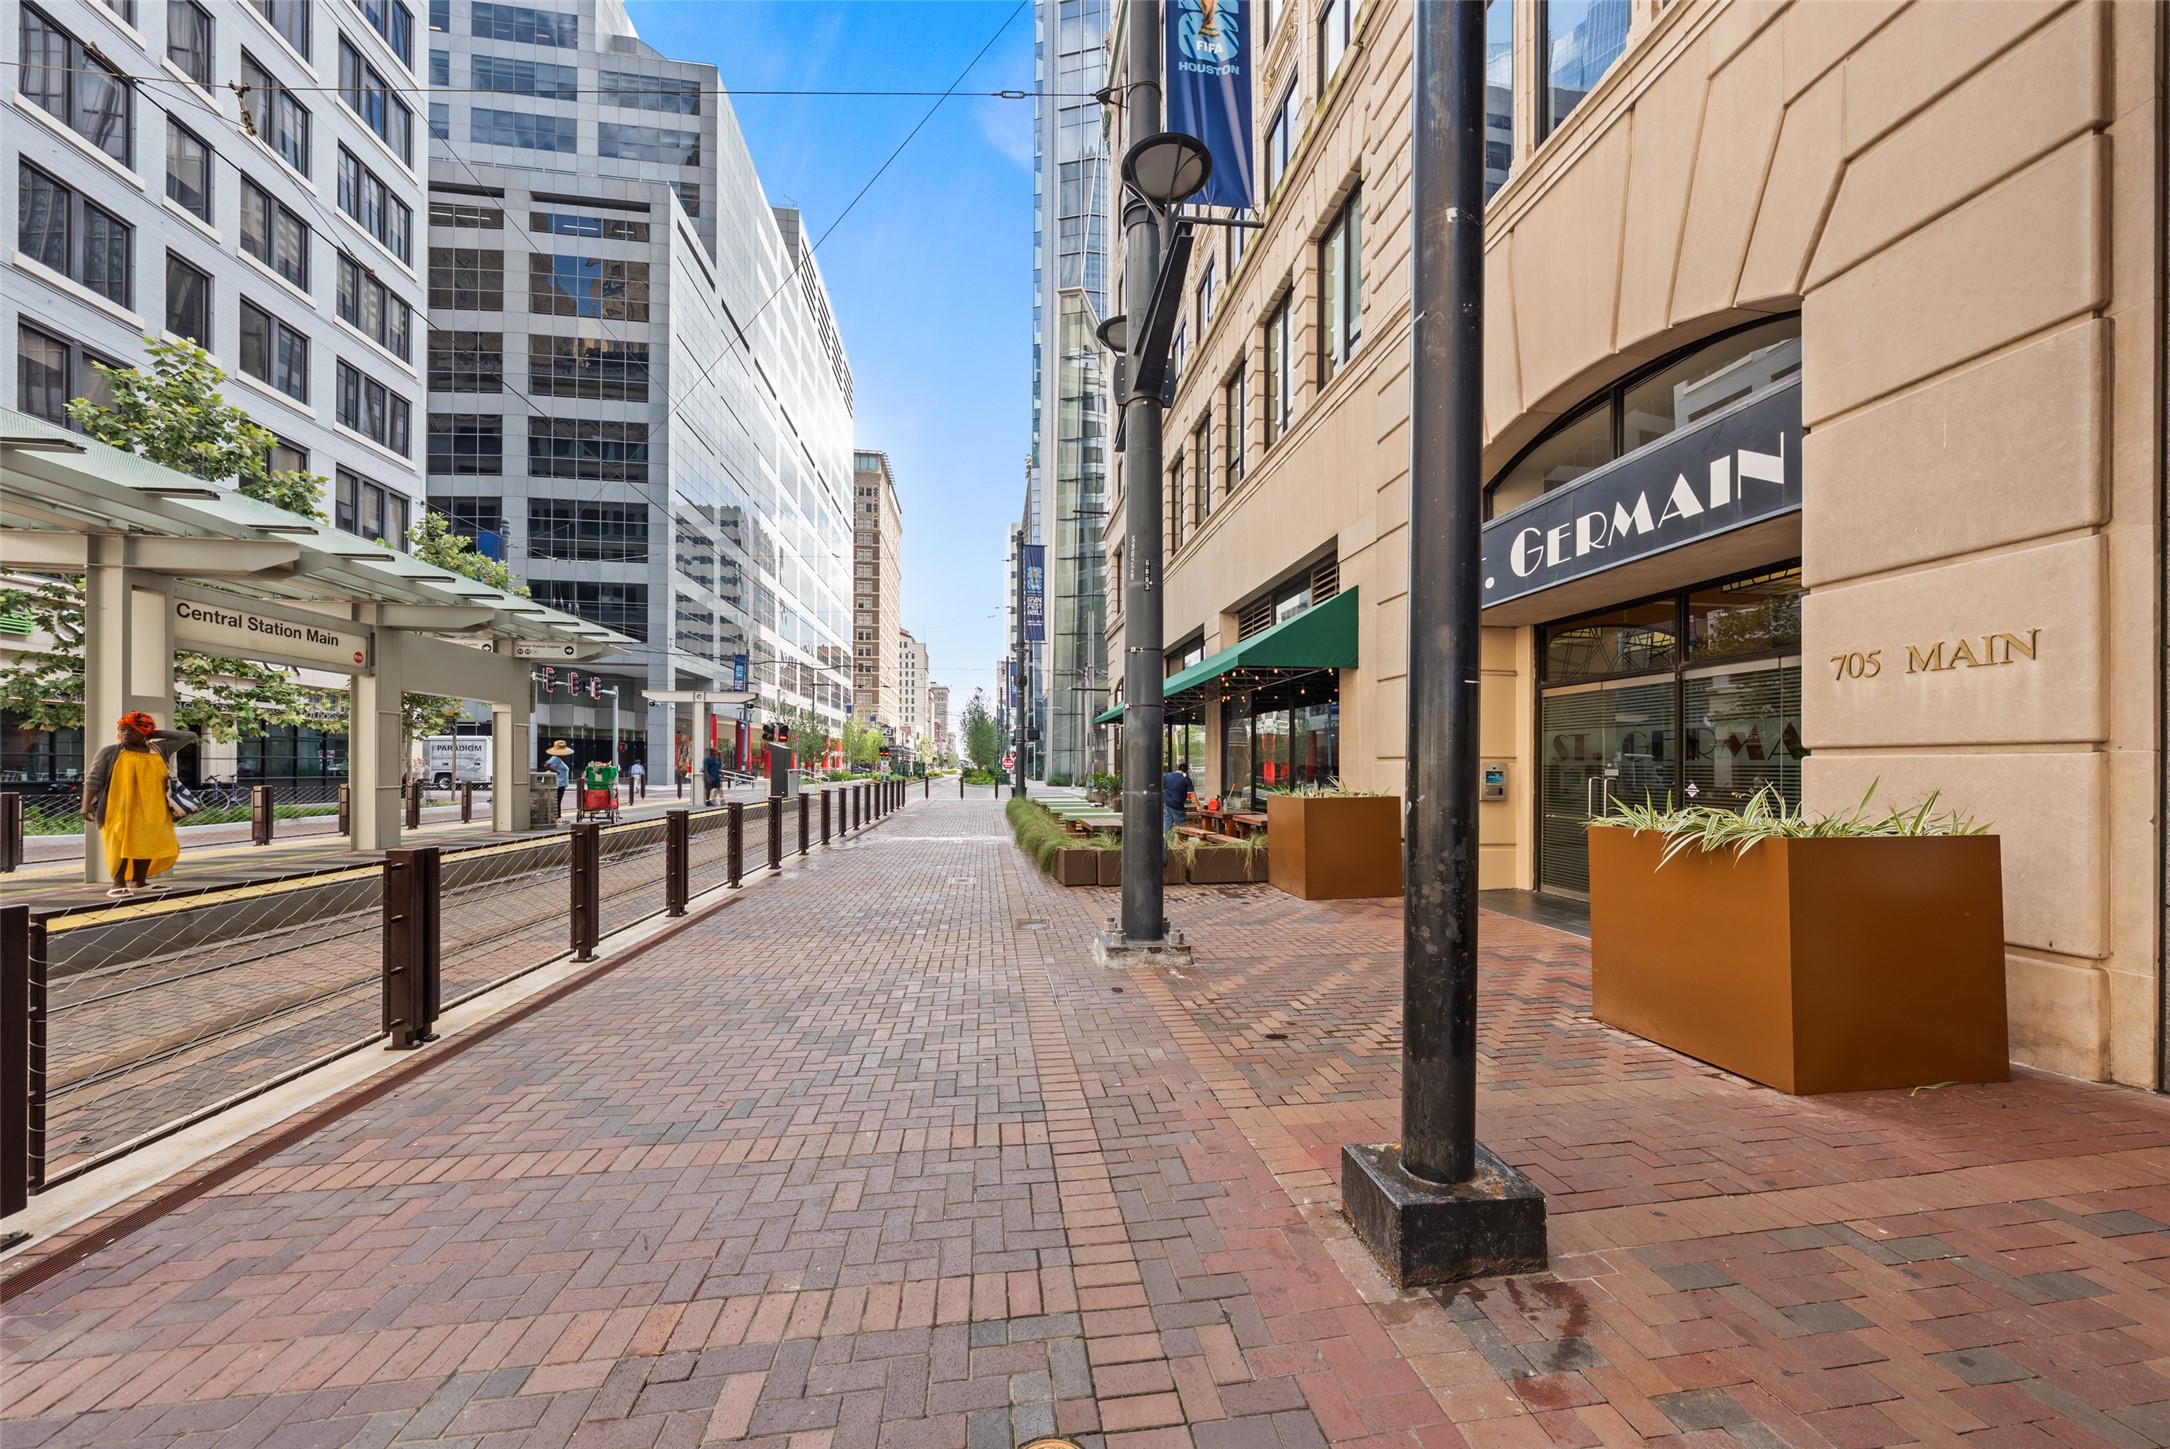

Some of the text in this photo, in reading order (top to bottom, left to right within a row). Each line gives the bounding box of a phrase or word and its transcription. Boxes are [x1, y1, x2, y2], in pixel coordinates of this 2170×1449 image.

[1196, 40, 1224, 54] FIFA
[1178, 61, 1240, 76] HOUSTON
[1510, 432, 1785, 578] GERMAIN
[176, 602, 339, 647] Central Station Main
[1830, 628, 2042, 681] 705 MAIN
[1552, 733, 1603, 763] ST.
